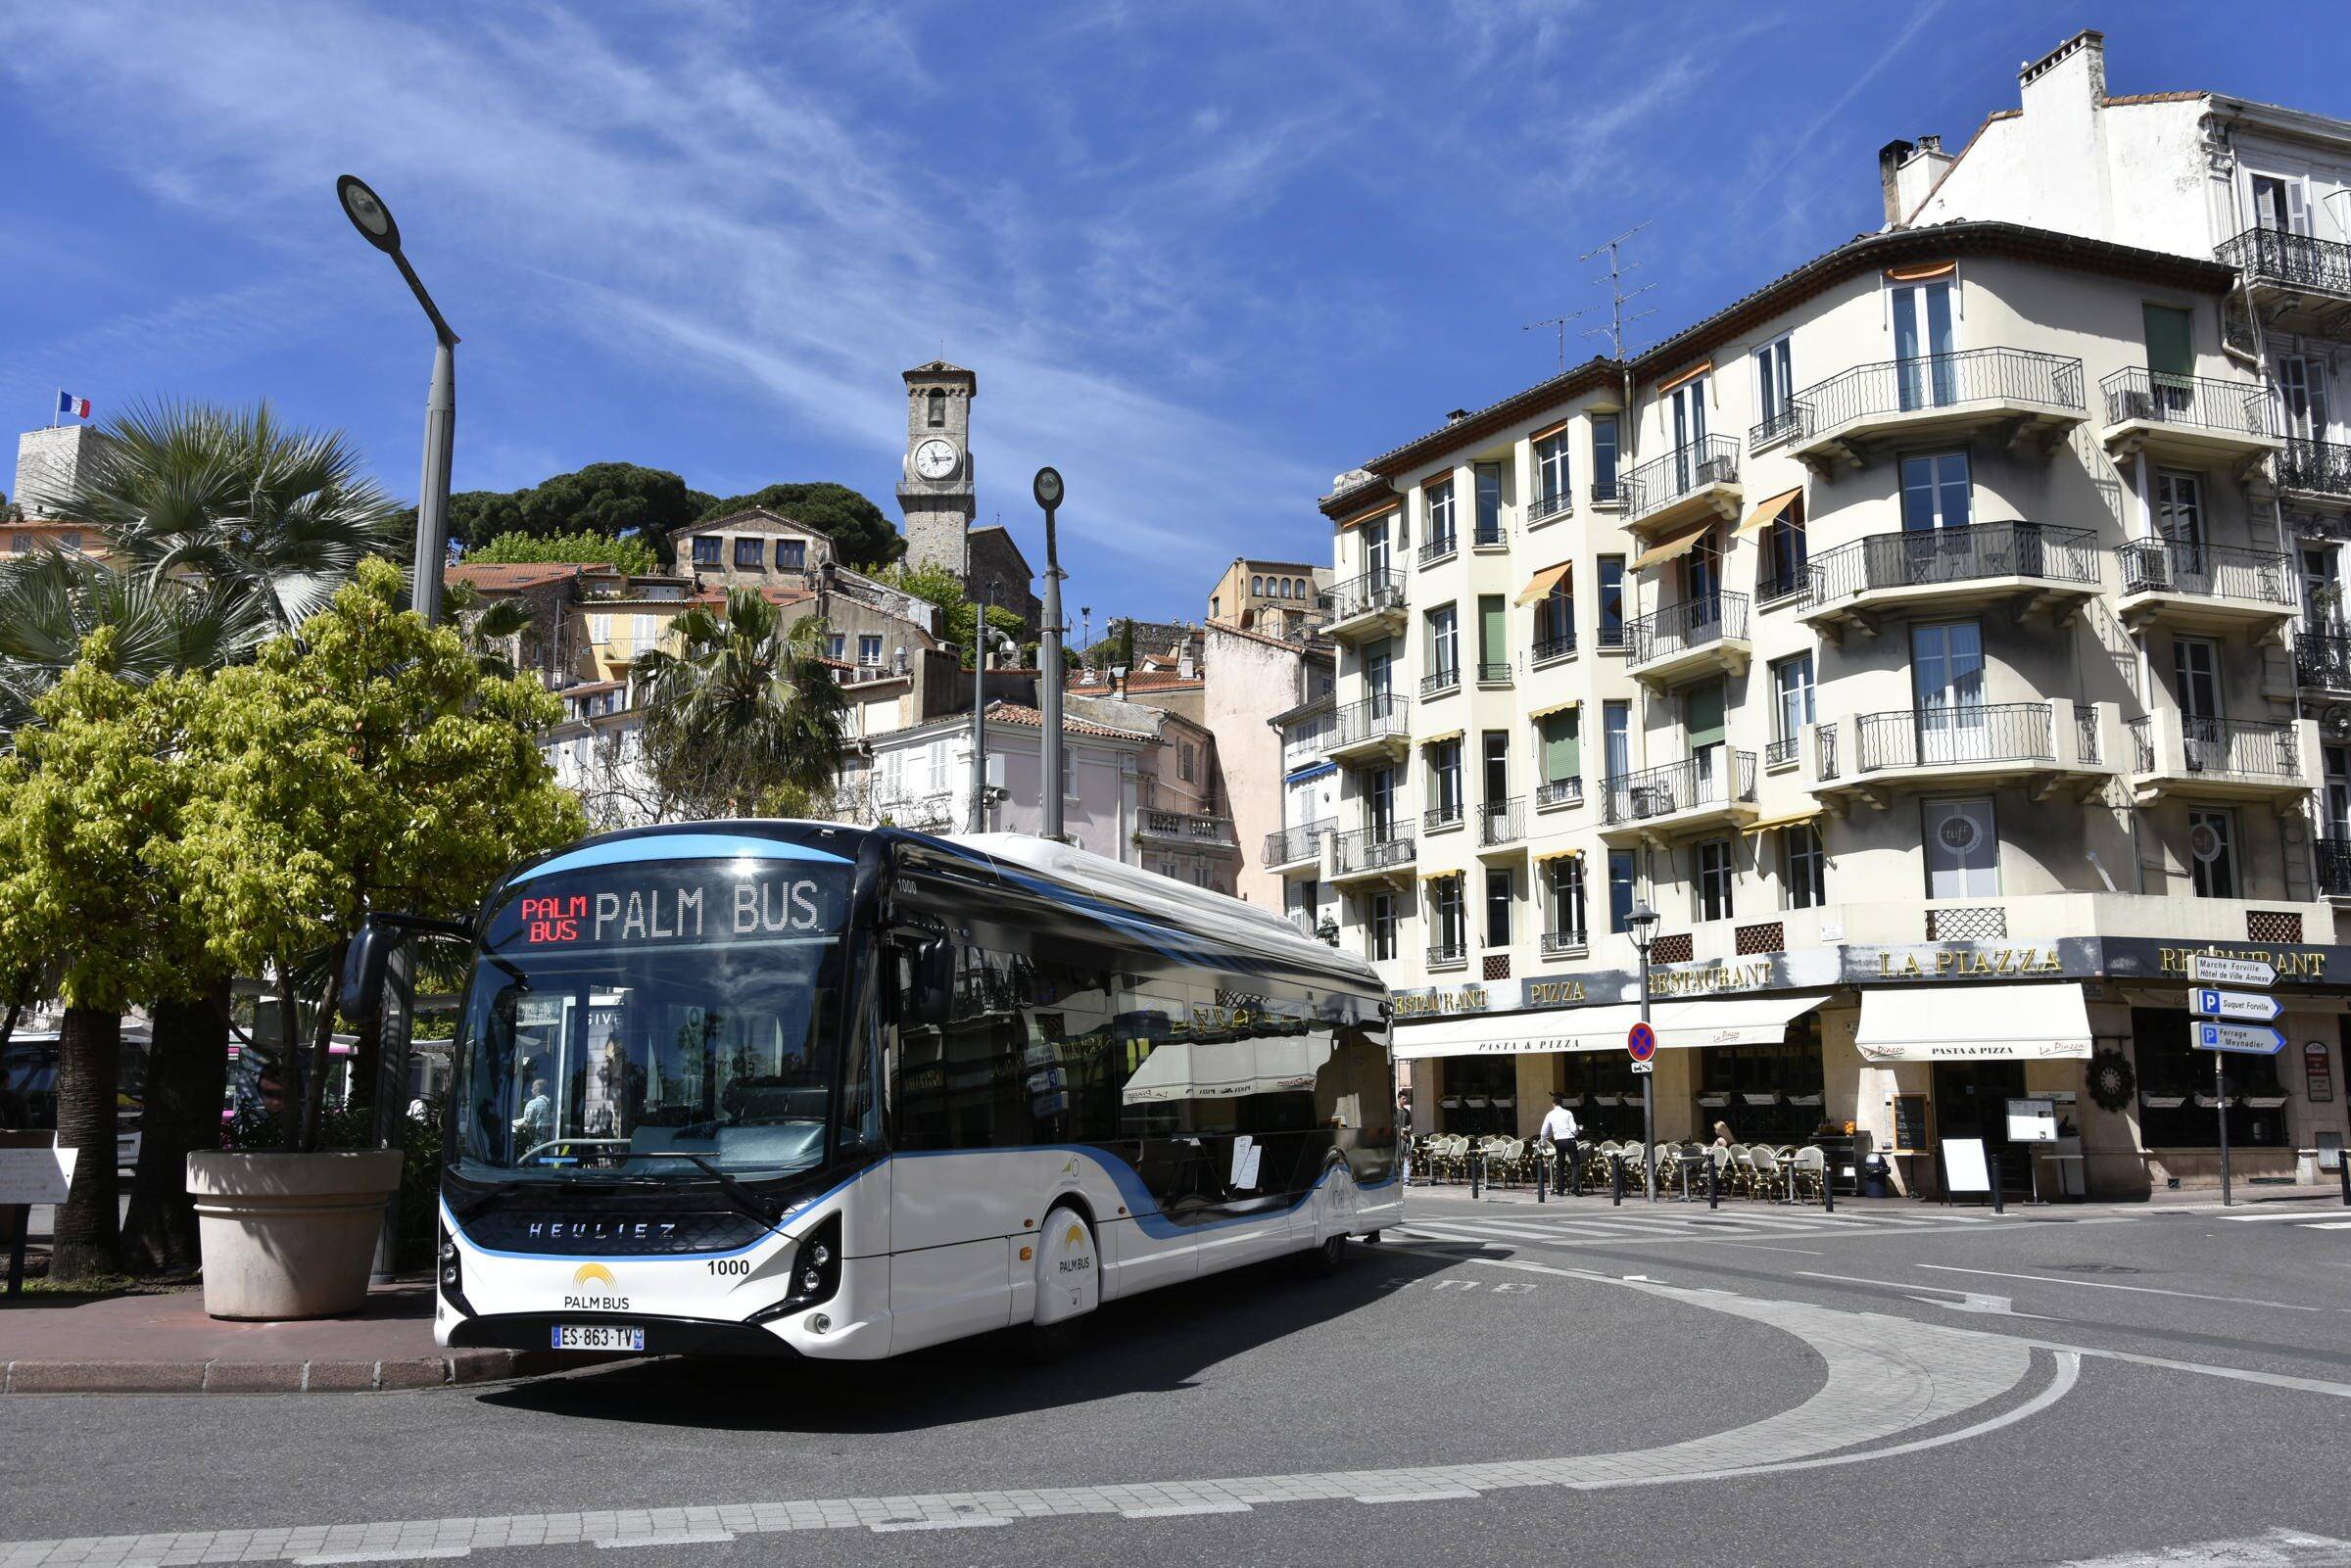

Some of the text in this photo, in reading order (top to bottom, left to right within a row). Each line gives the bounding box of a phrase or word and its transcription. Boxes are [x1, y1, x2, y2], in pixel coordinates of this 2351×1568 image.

[896, 878, 918, 895] 1000
[521, 896, 587, 920] PALM
[595, 879, 818, 941] PALM BUS
[529, 920, 578, 942] BUS
[1879, 948, 2062, 976] LA PIAZZA
[2159, 948, 2326, 974] RERANT
[2199, 960, 2259, 972] Marché Forville
[1649, 963, 1772, 994] RESTAURANT
[2230, 972, 2243, 980] Ville
[1531, 981, 1586, 1004] PIZZA
[1394, 989, 1489, 1015] ESTAURANT
[2223, 999, 2269, 1012] Suquet Forville
[2219, 1028, 2247, 1039] Ferrage
[1478, 1041, 1517, 1051] PASTA
[1539, 1039, 1580, 1049] PIZZA
[528, 1222, 677, 1239] HEULIEZ
[706, 1259, 750, 1276] 1000
[1059, 1256, 1089, 1273] PALM BUS
[564, 1296, 630, 1310] PALM BUS
[561, 1327, 632, 1347] ES-863-TV
